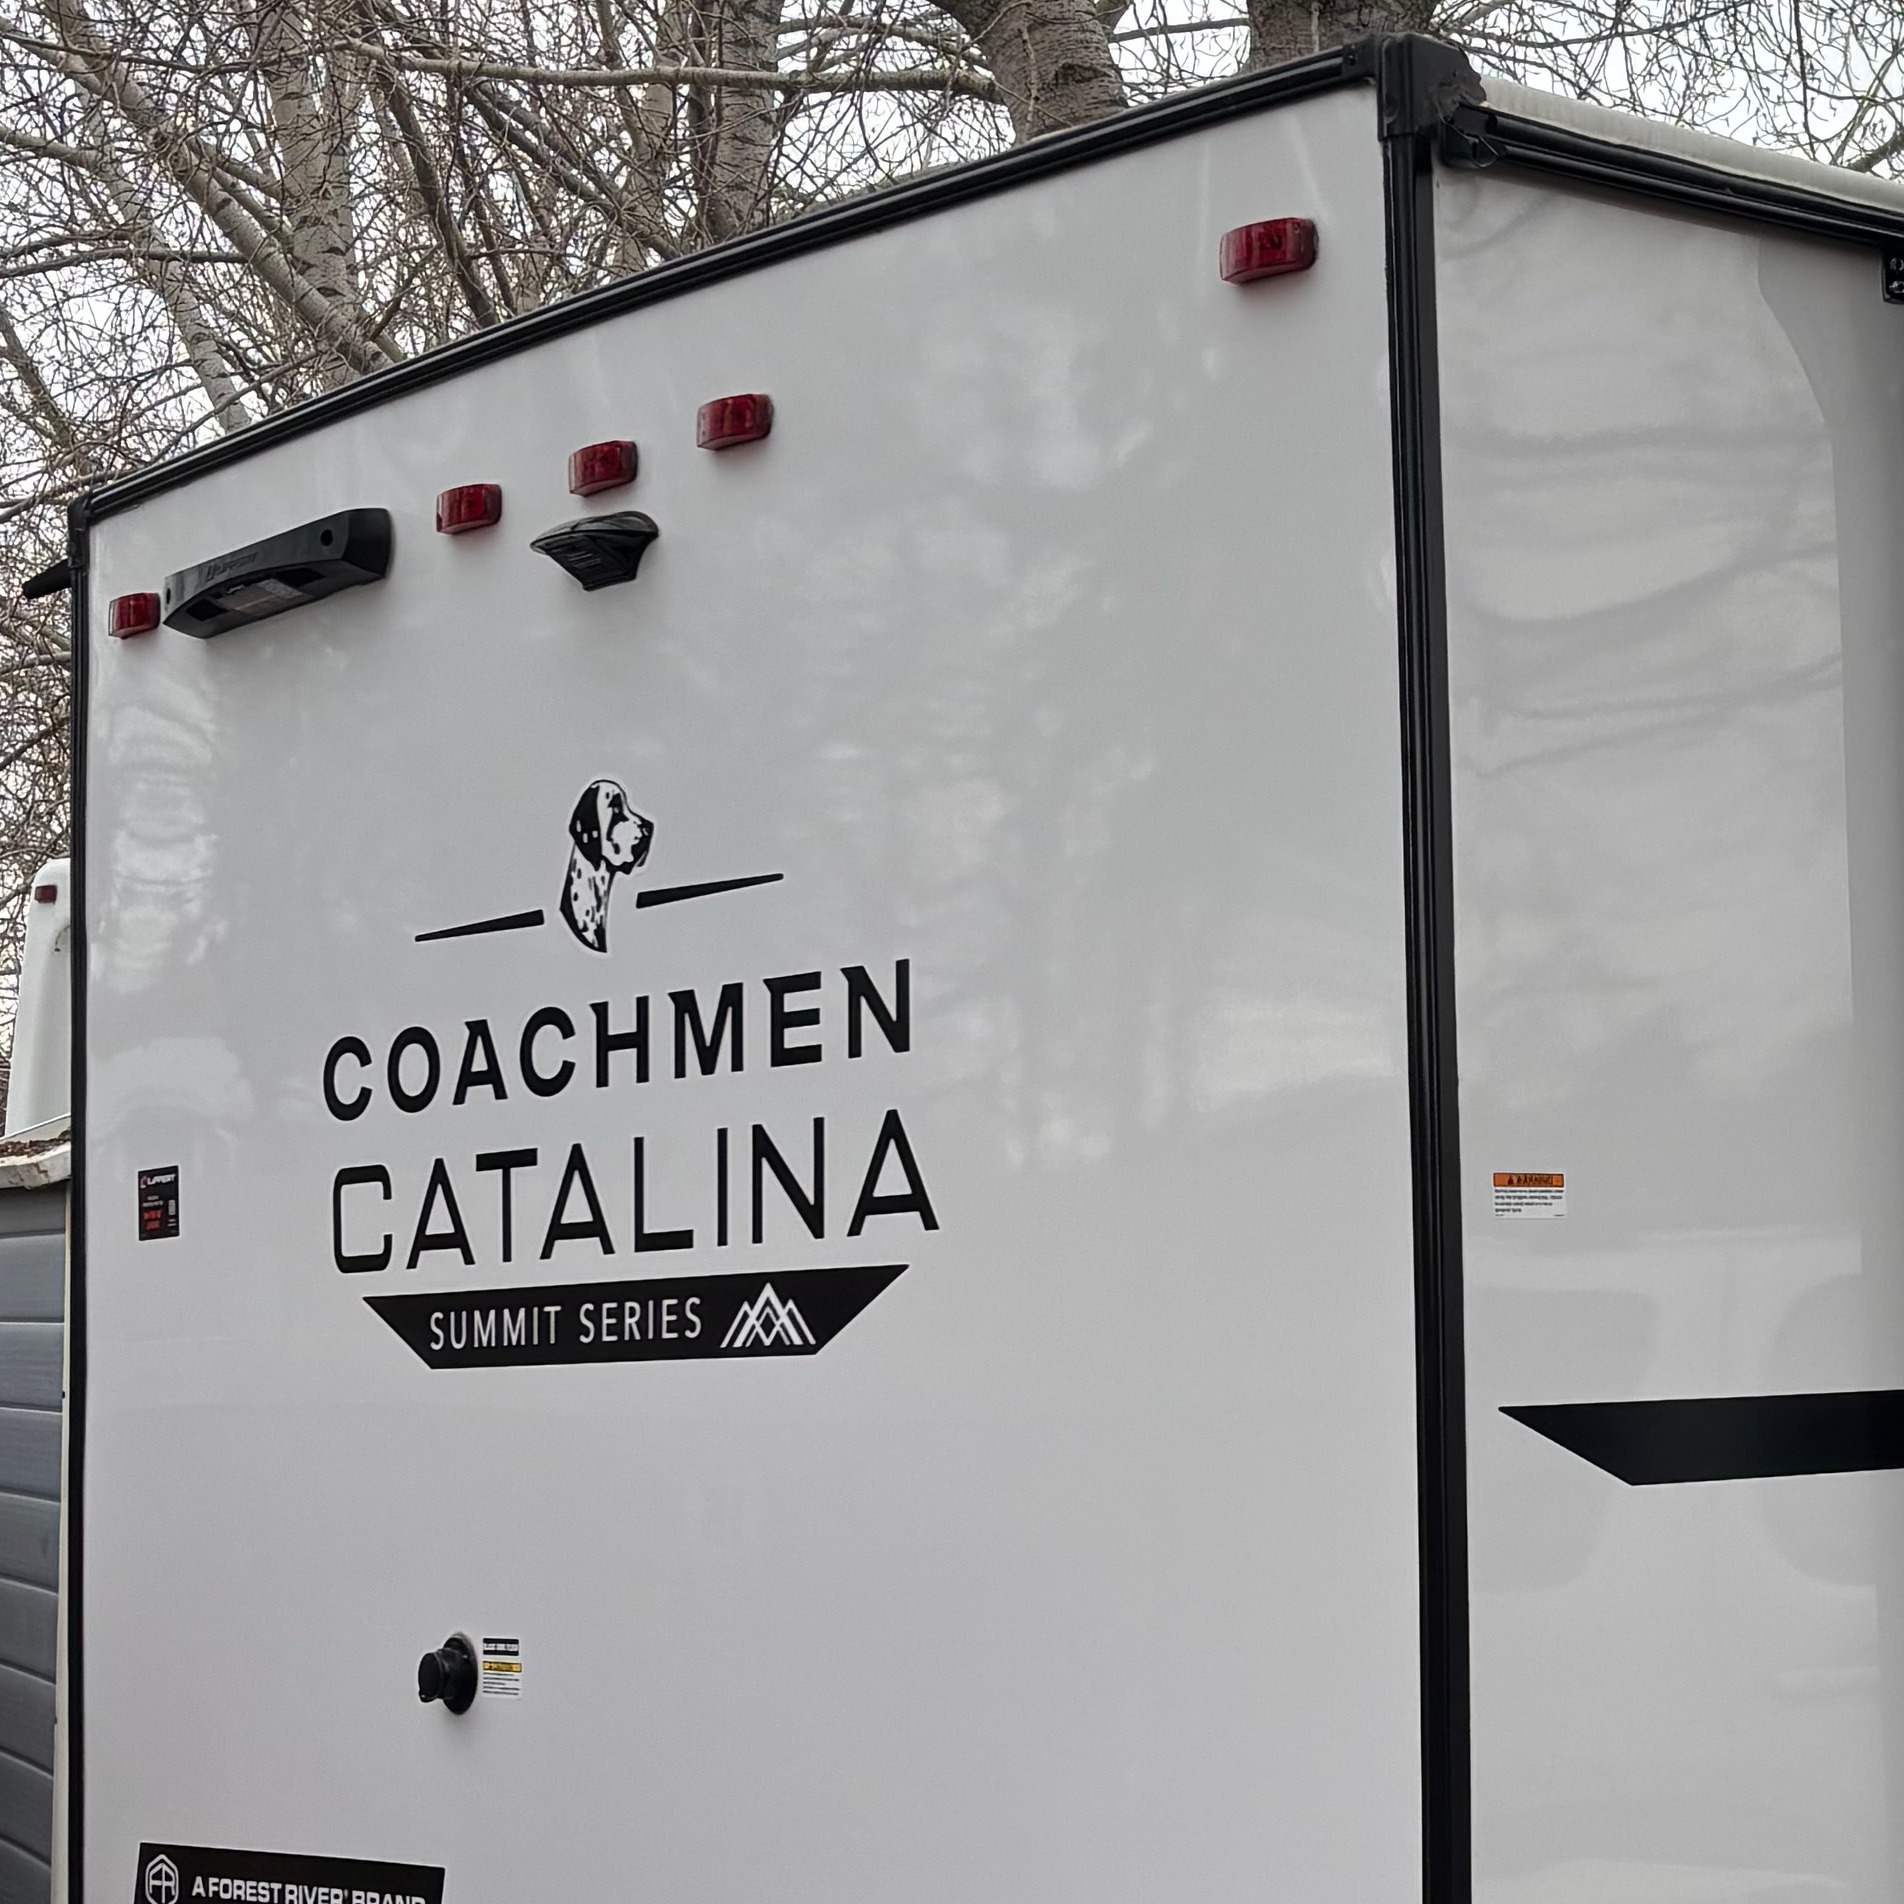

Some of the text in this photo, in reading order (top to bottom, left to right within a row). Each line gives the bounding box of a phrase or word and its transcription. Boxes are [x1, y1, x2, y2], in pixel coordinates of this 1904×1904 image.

[322, 958, 912, 1122] COACHMEN
[332, 1109, 940, 1275] CATALINA
[429, 1296, 703, 1352] SUMMIT SERIES
[191, 1875, 206, 1897] A
[208, 1877, 282, 1904] FOREST
